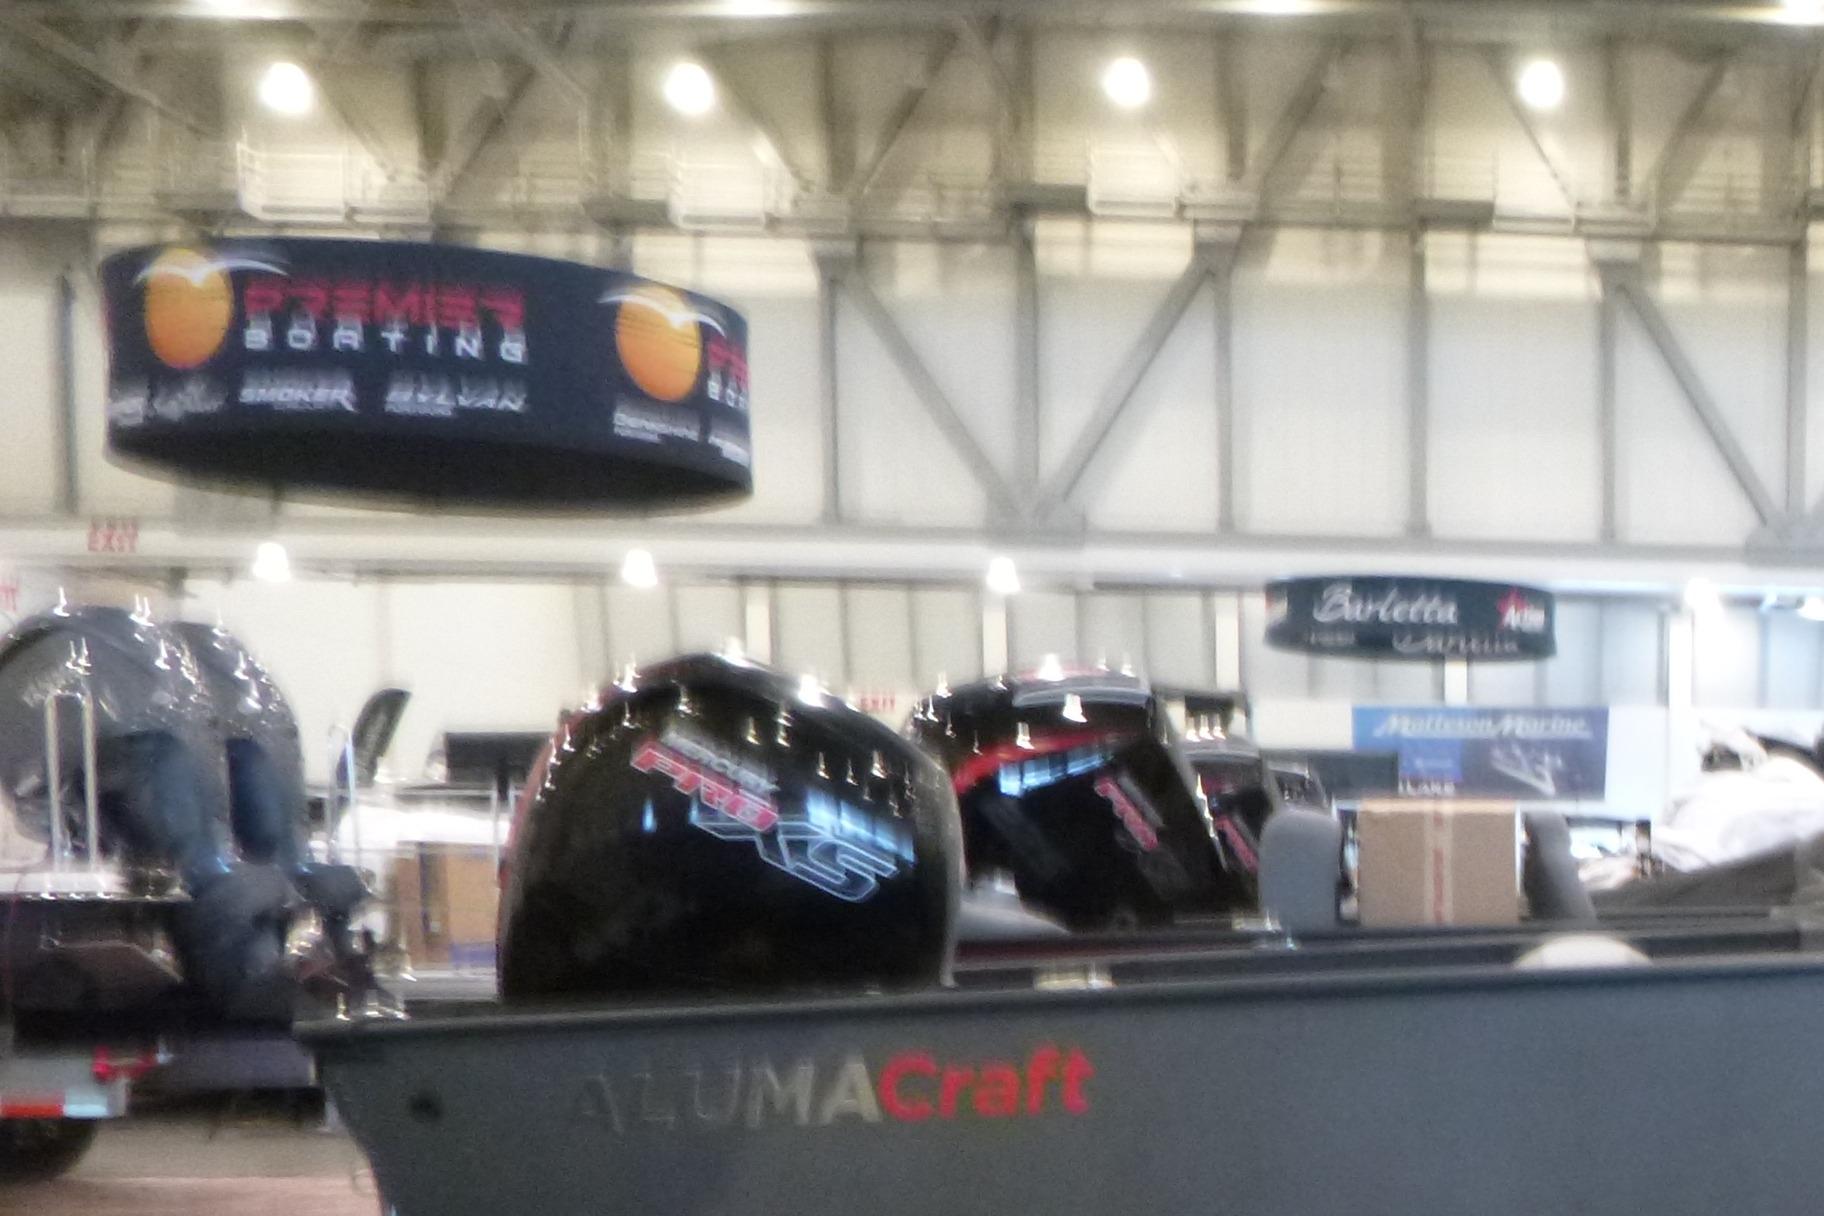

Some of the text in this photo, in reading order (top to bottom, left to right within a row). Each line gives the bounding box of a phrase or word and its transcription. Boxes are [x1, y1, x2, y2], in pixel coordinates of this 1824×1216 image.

[244, 279, 524, 328] PREMIER
[244, 324, 527, 364] BOATING
[239, 385, 357, 413] SMOKER
[87, 526, 138, 551] EXIT
[630, 738, 779, 832] PRO
